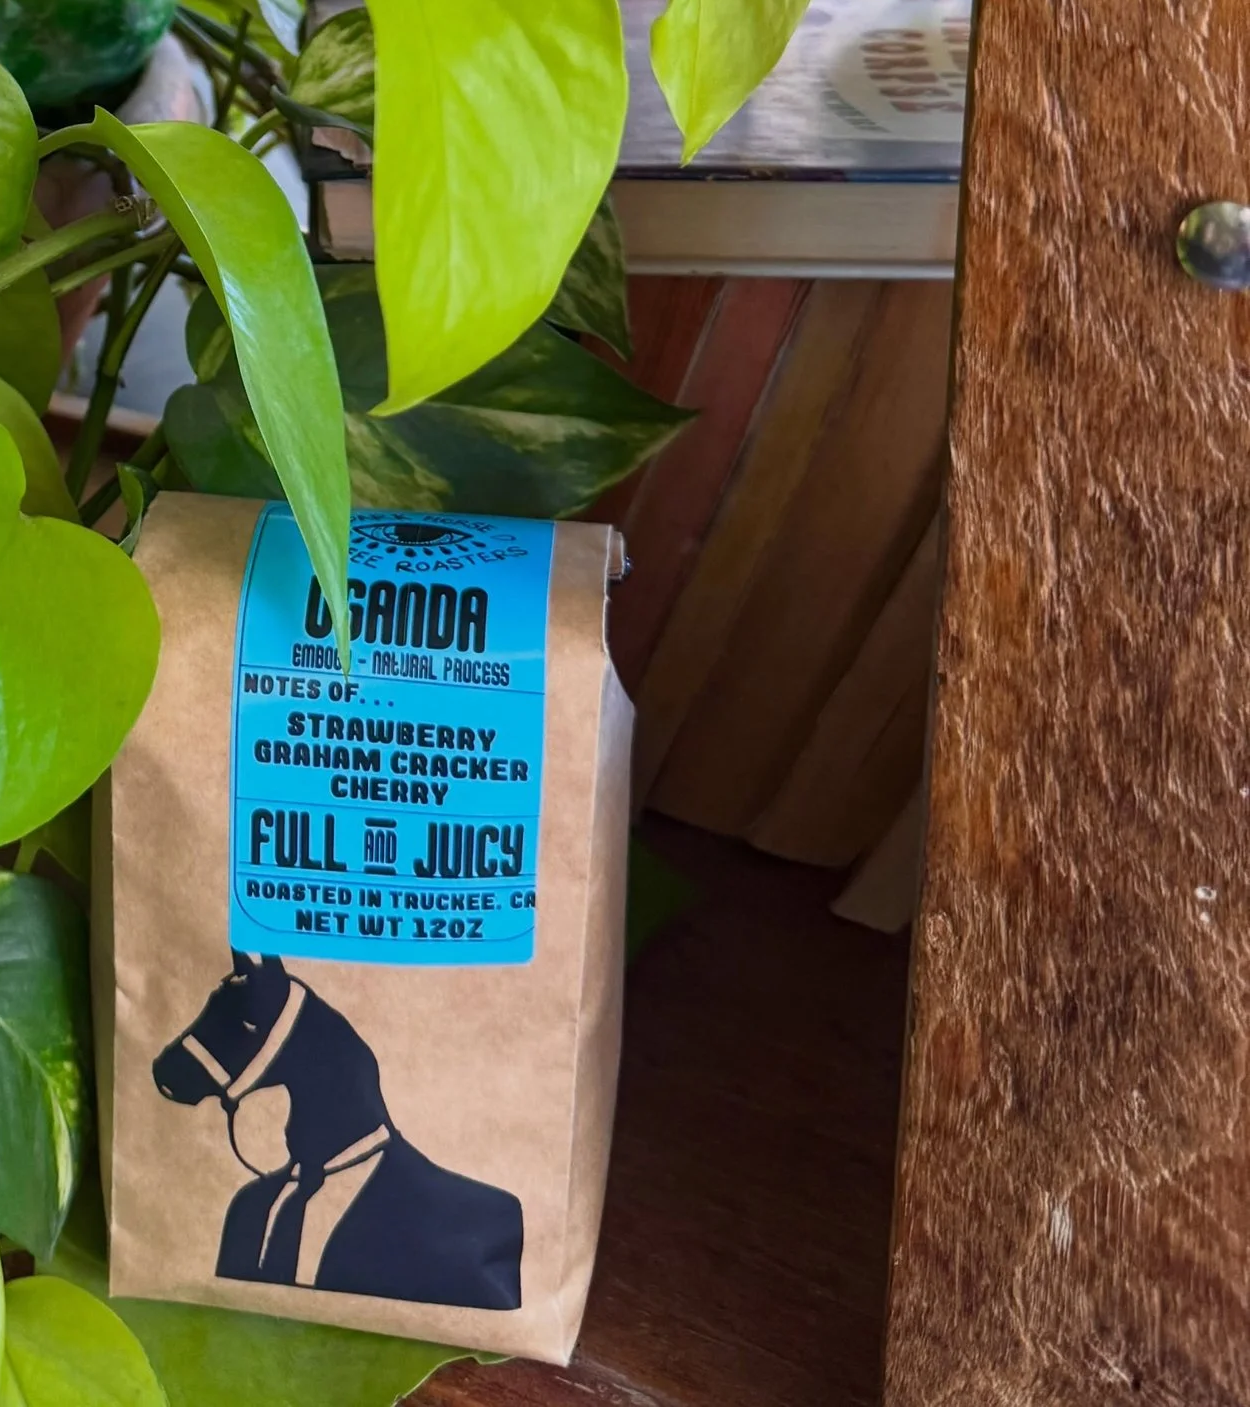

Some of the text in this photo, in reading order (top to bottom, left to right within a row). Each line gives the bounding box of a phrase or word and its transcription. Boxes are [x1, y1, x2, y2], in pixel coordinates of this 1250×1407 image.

[395, 546, 528, 574] ROASTERS
[293, 643, 352, 670] EMBOG
[372, 650, 437, 680] NATURAL
[443, 657, 510, 686] PROCESS
[244, 672, 321, 700] NOTES
[287, 711, 496, 752] STRAWBERRY
[254, 739, 528, 781] GRAHAM CRACKER
[330, 775, 449, 806] CHERRY
[251, 808, 524, 878] FULL AND JUICY
[246, 879, 352, 906] ROASTED
[359, 888, 382, 908] IN
[510, 891, 536, 909] CA
[295, 910, 484, 940] NET WT 12OZ
